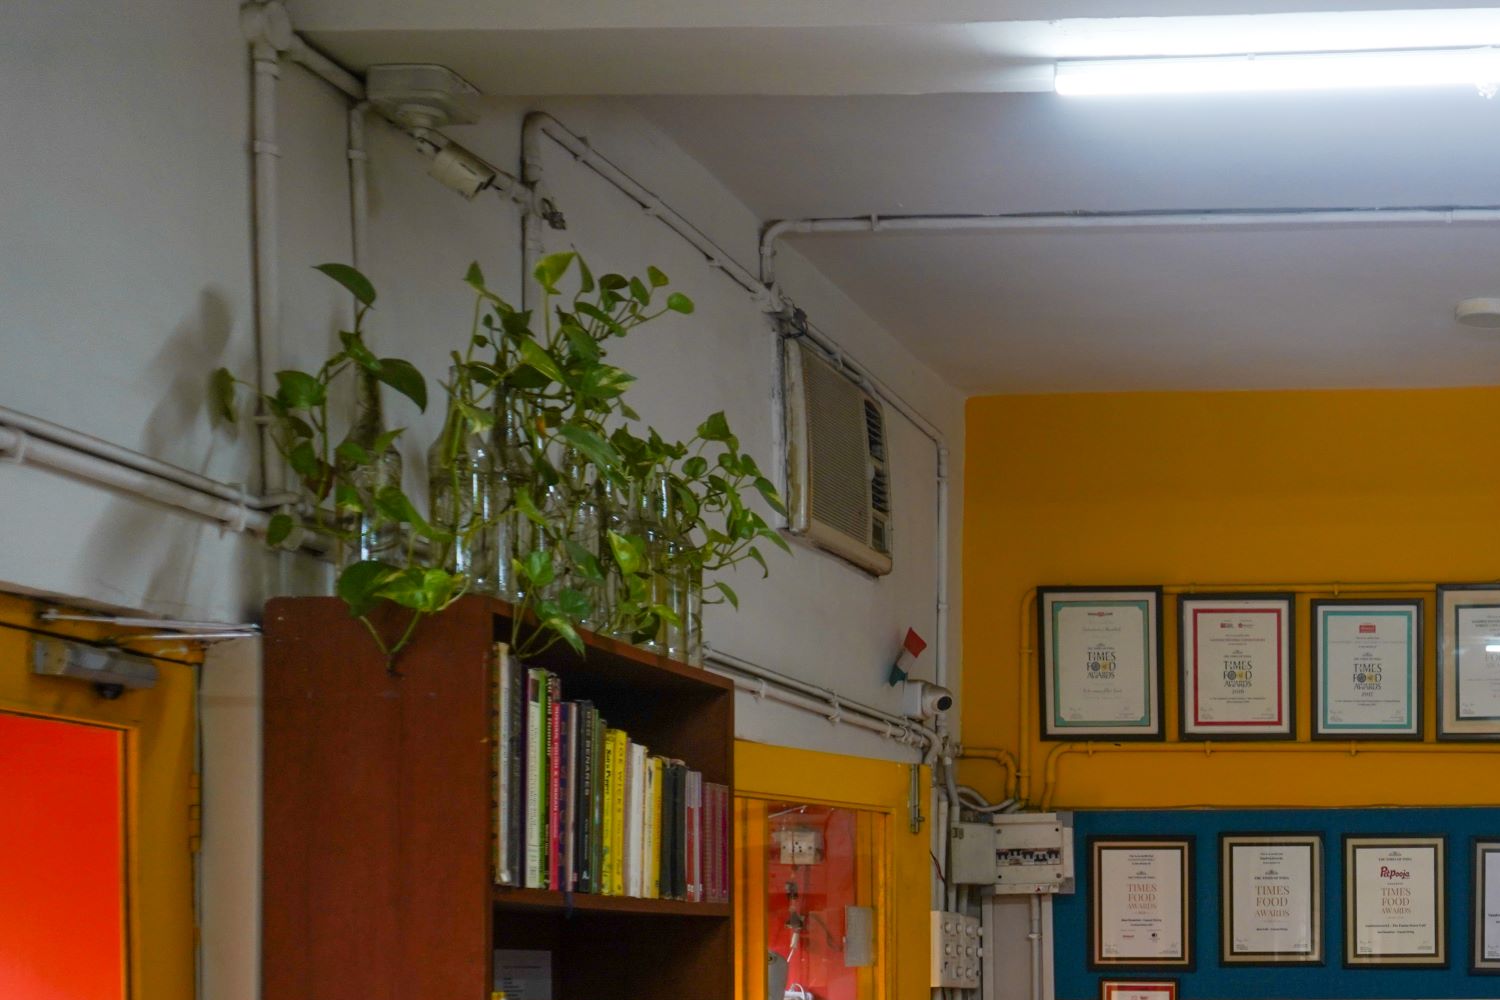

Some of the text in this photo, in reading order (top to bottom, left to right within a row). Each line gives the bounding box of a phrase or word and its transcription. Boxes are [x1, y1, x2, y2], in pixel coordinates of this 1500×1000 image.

[1088, 651, 1116, 660] TIMES
[1224, 661, 1252, 670] TIMES
[1354, 663, 1381, 672] TIMES
[1127, 884, 1157, 892] TIMES
[1255, 885, 1289, 895] TIMES
[1381, 887, 1410, 896] TIMES
[1128, 893, 1155, 901] FOOD
[1256, 897, 1287, 906] FOOD
[1382, 897, 1409, 905] FOOD
[1256, 909, 1290, 917] AWARDS
